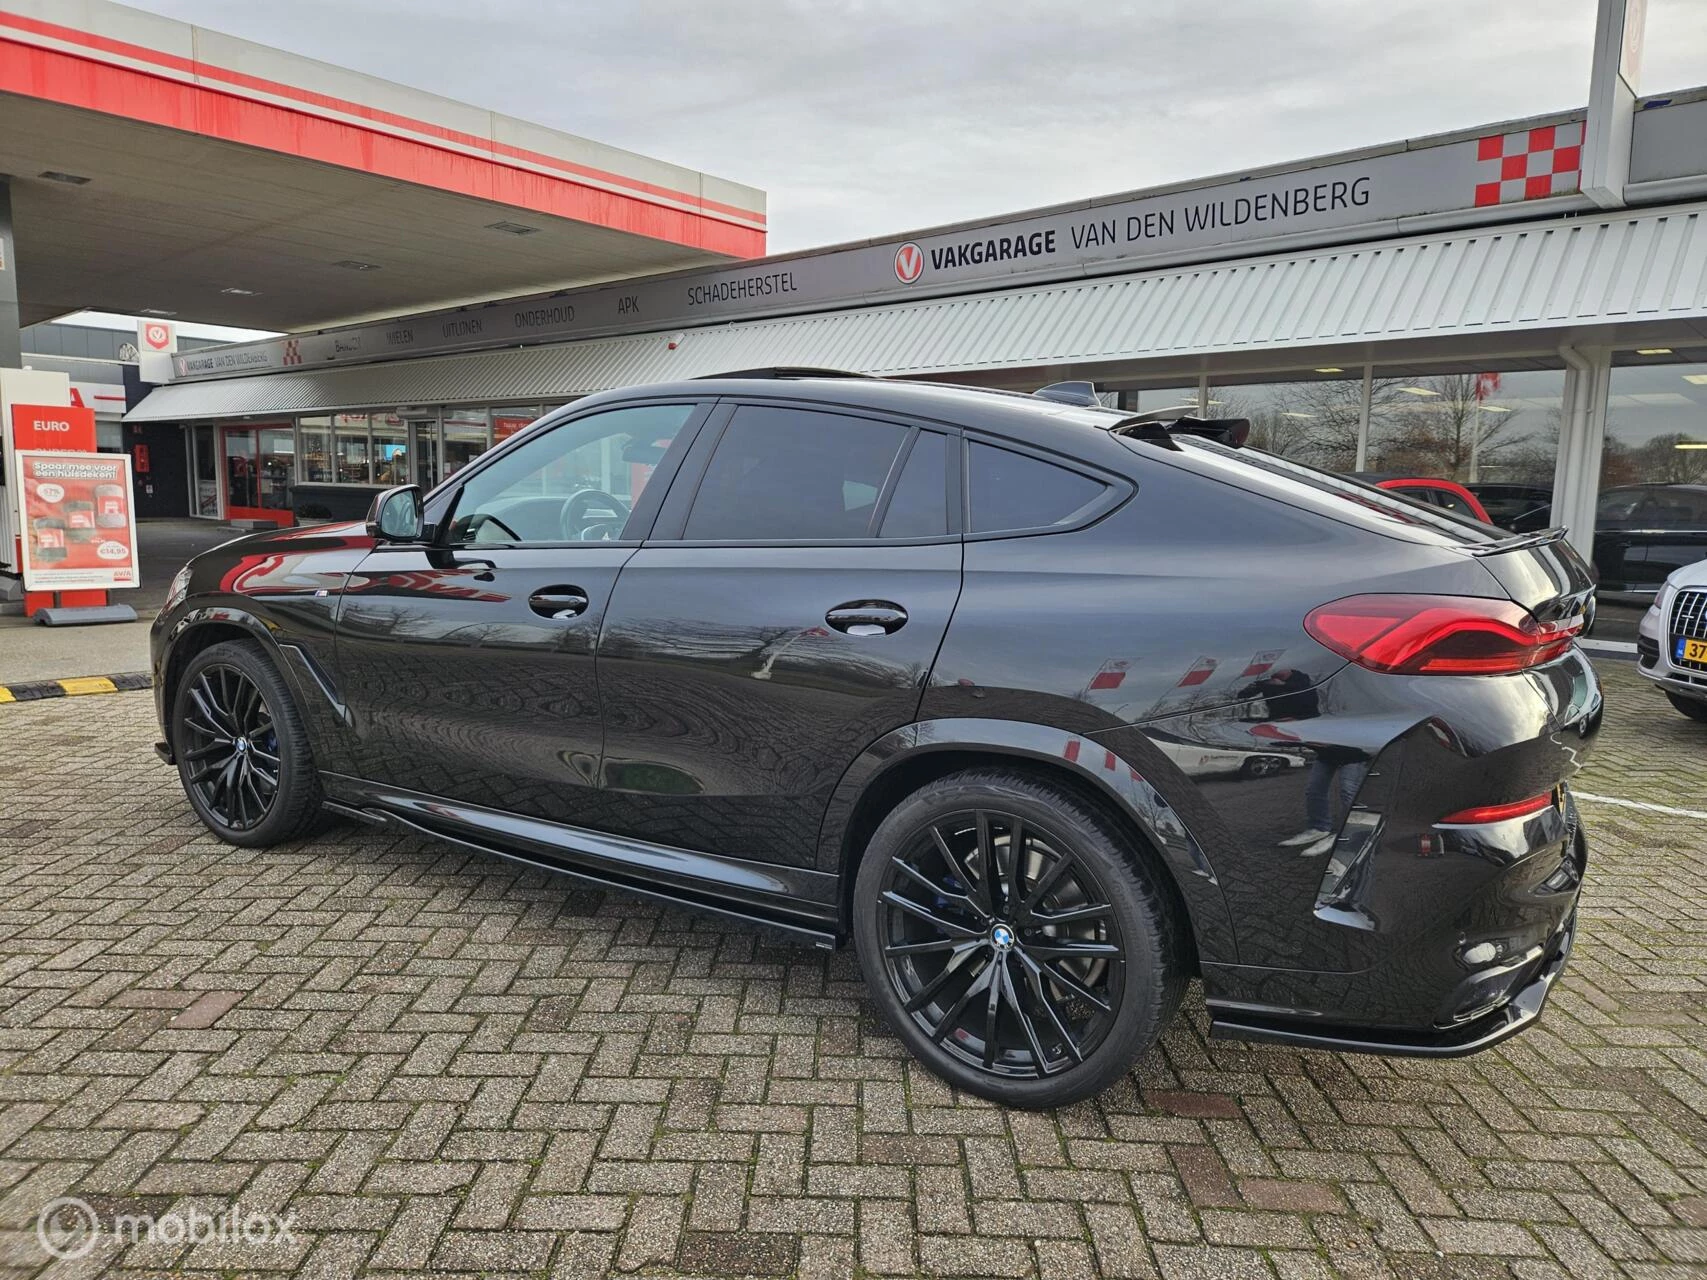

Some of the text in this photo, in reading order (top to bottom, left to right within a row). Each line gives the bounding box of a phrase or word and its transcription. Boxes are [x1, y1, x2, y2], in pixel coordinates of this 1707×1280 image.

[931, 230, 1056, 270] VAKGARAGE
[1071, 219, 1116, 249] VAN
[1126, 209, 1174, 242] DEN
[1184, 177, 1371, 232] WILDENBERG
[687, 272, 798, 306] SCHADEHERSTEL
[514, 305, 575, 329] ONDERHOUD
[617, 296, 640, 315] APK
[33, 420, 70, 432] EURO
